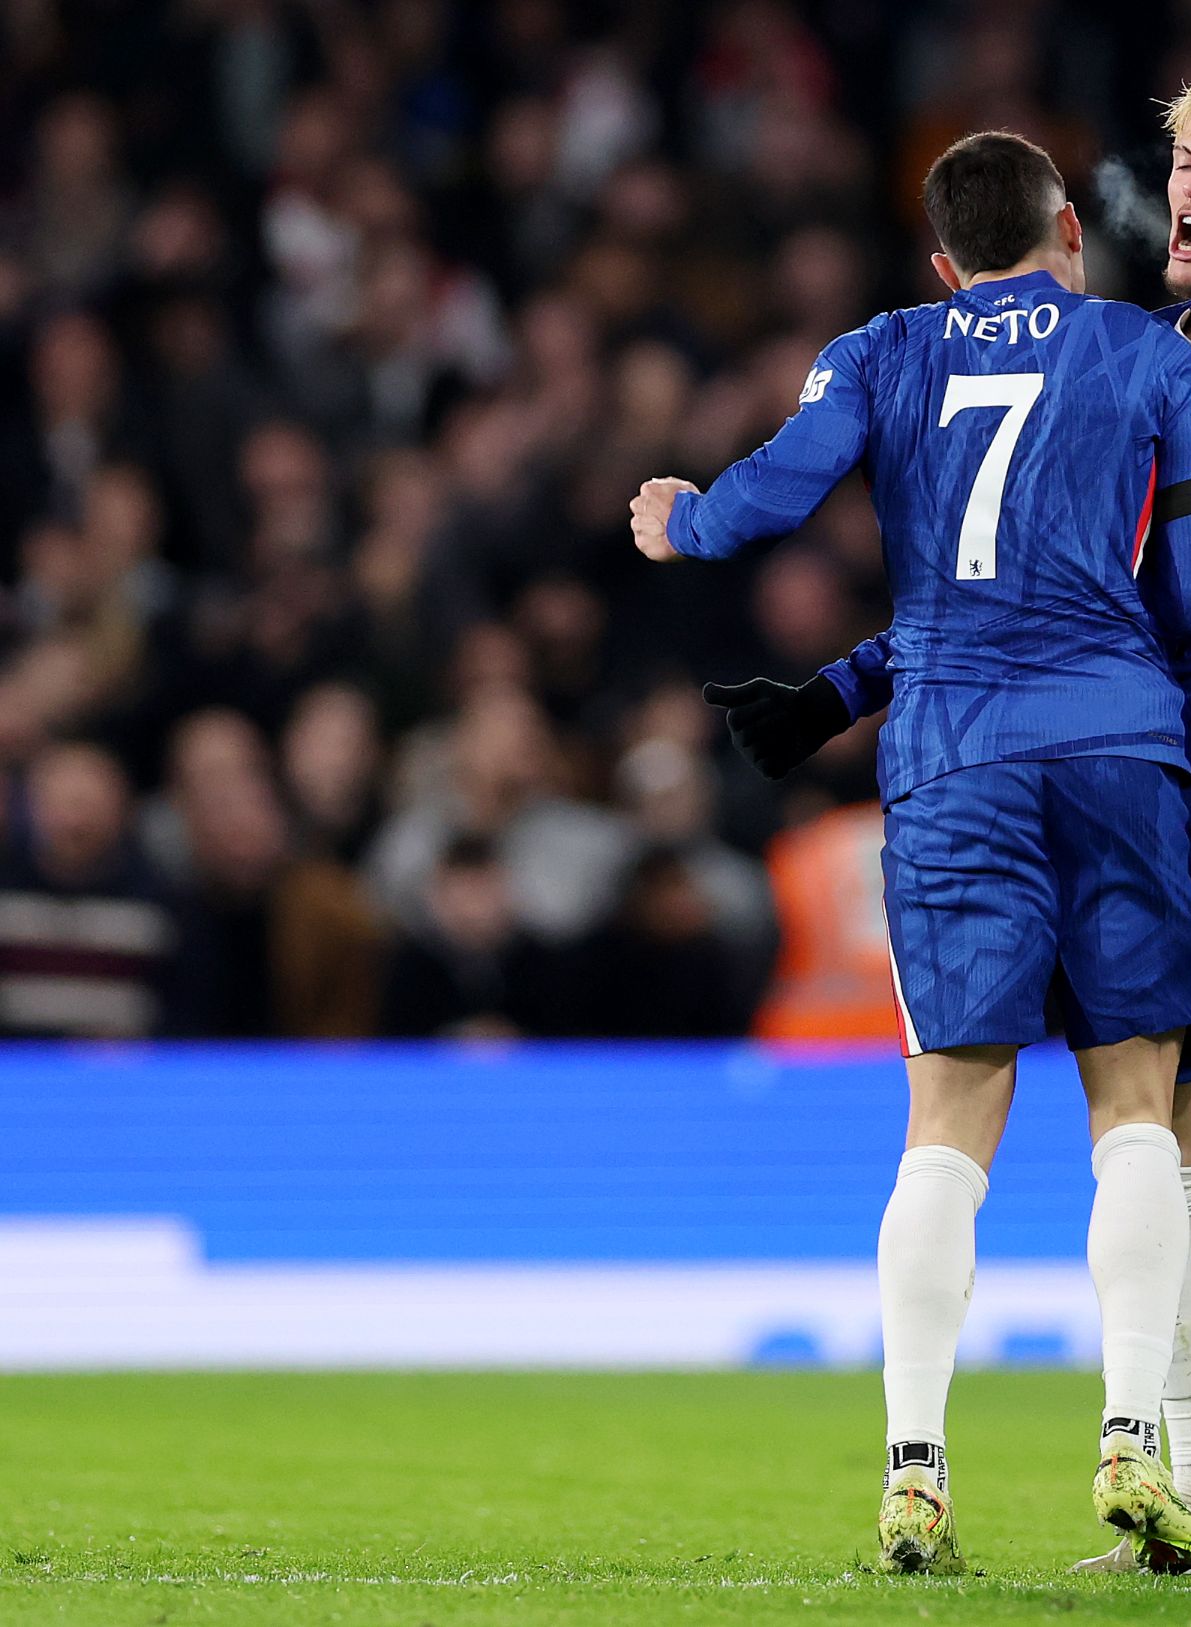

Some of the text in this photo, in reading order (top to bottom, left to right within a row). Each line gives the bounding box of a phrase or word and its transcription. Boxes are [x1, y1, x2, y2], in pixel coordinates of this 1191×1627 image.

[993, 294, 1015, 306] CFC
[942, 303, 1060, 345] NETO
[938, 372, 1045, 581] 7
